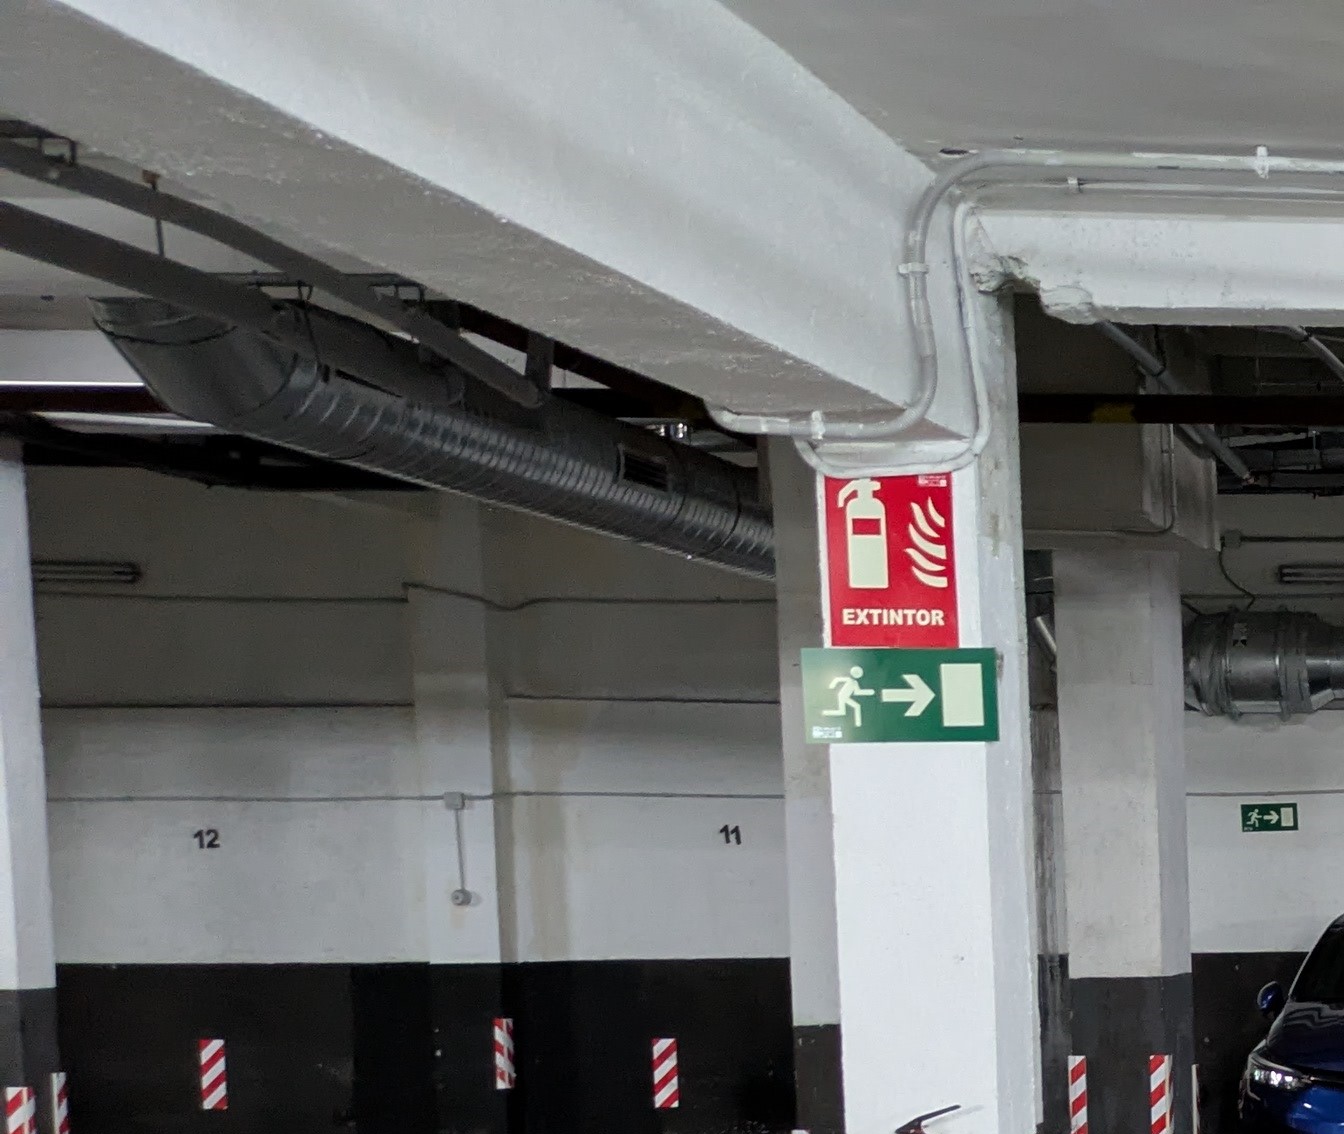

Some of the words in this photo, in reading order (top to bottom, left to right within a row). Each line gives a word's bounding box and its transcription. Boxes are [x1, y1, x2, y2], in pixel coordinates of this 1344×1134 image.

[842, 608, 945, 626] EXTINTOR
[193, 829, 220, 849] 12
[719, 824, 742, 845] 11
